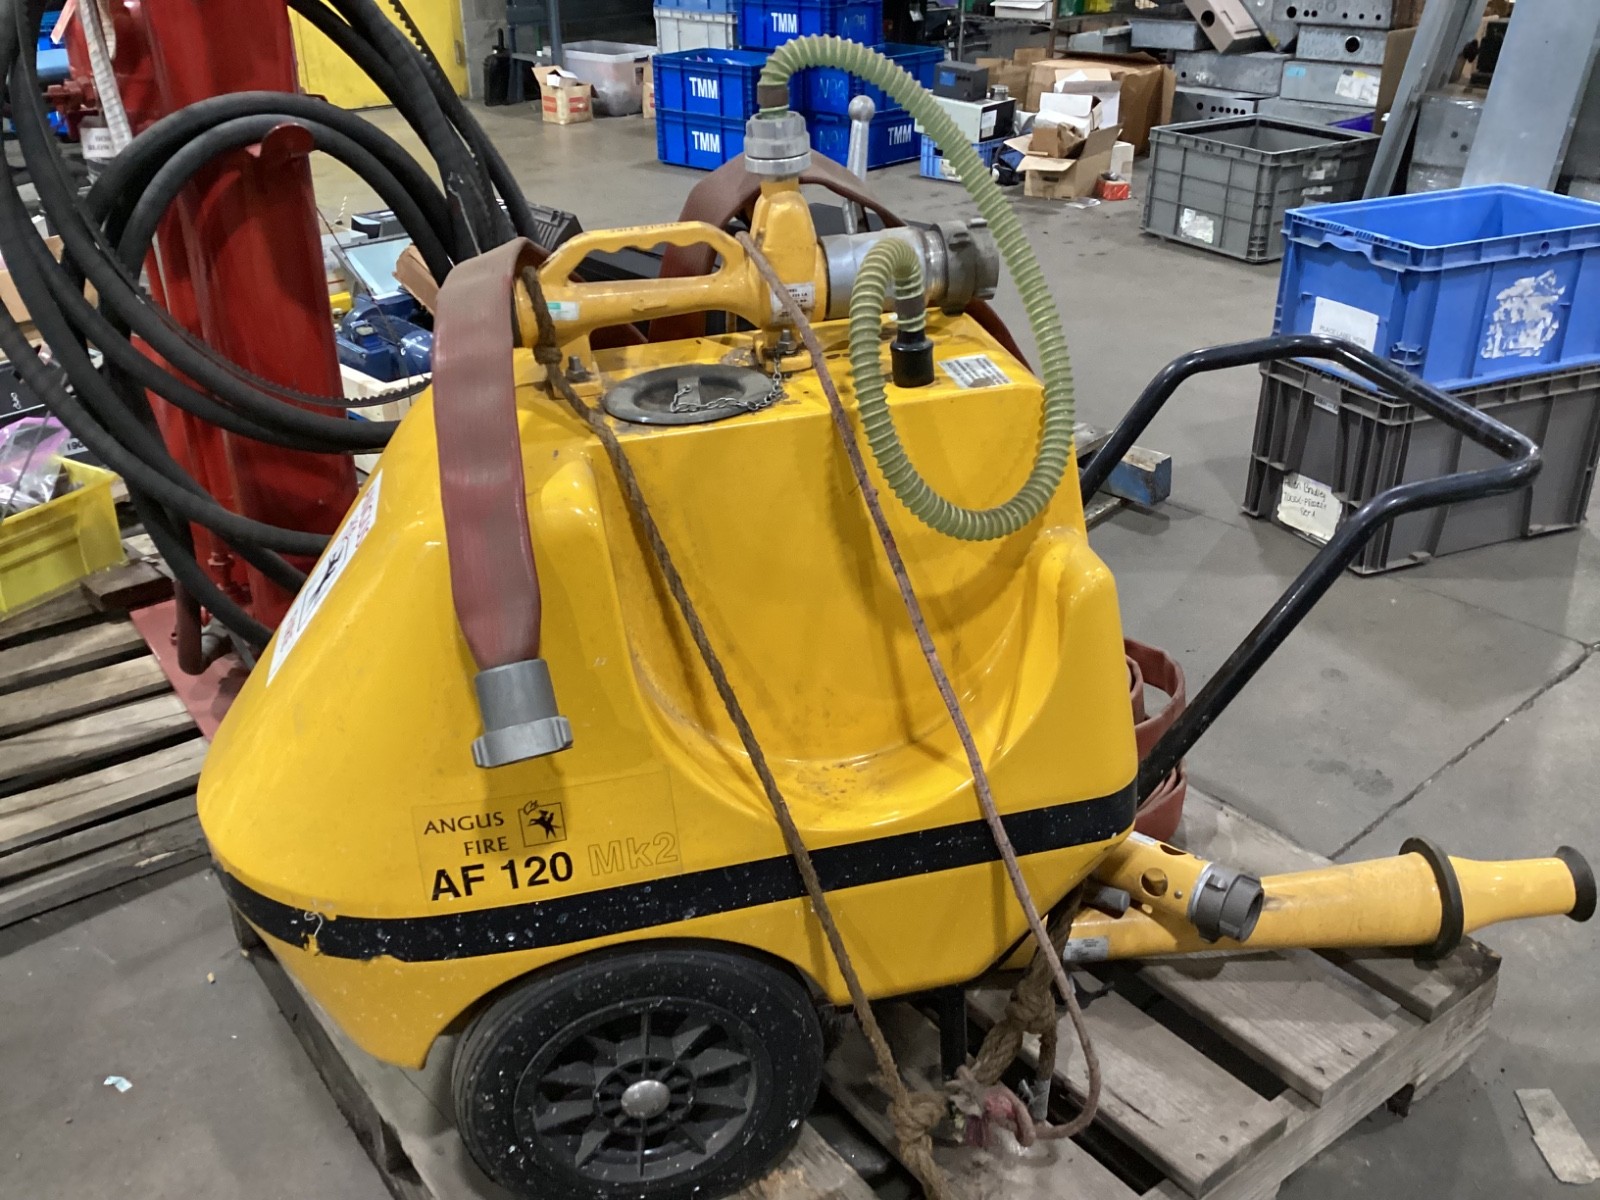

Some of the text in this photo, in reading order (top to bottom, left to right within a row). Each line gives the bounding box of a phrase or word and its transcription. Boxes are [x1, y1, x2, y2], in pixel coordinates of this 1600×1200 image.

[770, 12, 798, 34] TMM
[688, 76, 719, 100] TMM
[691, 130, 721, 154] TMM
[887, 123, 912, 146] TMM
[423, 811, 505, 836] ANGUS
[463, 836, 510, 857] FIRE
[431, 831, 679, 902] AF 120 Mk2
